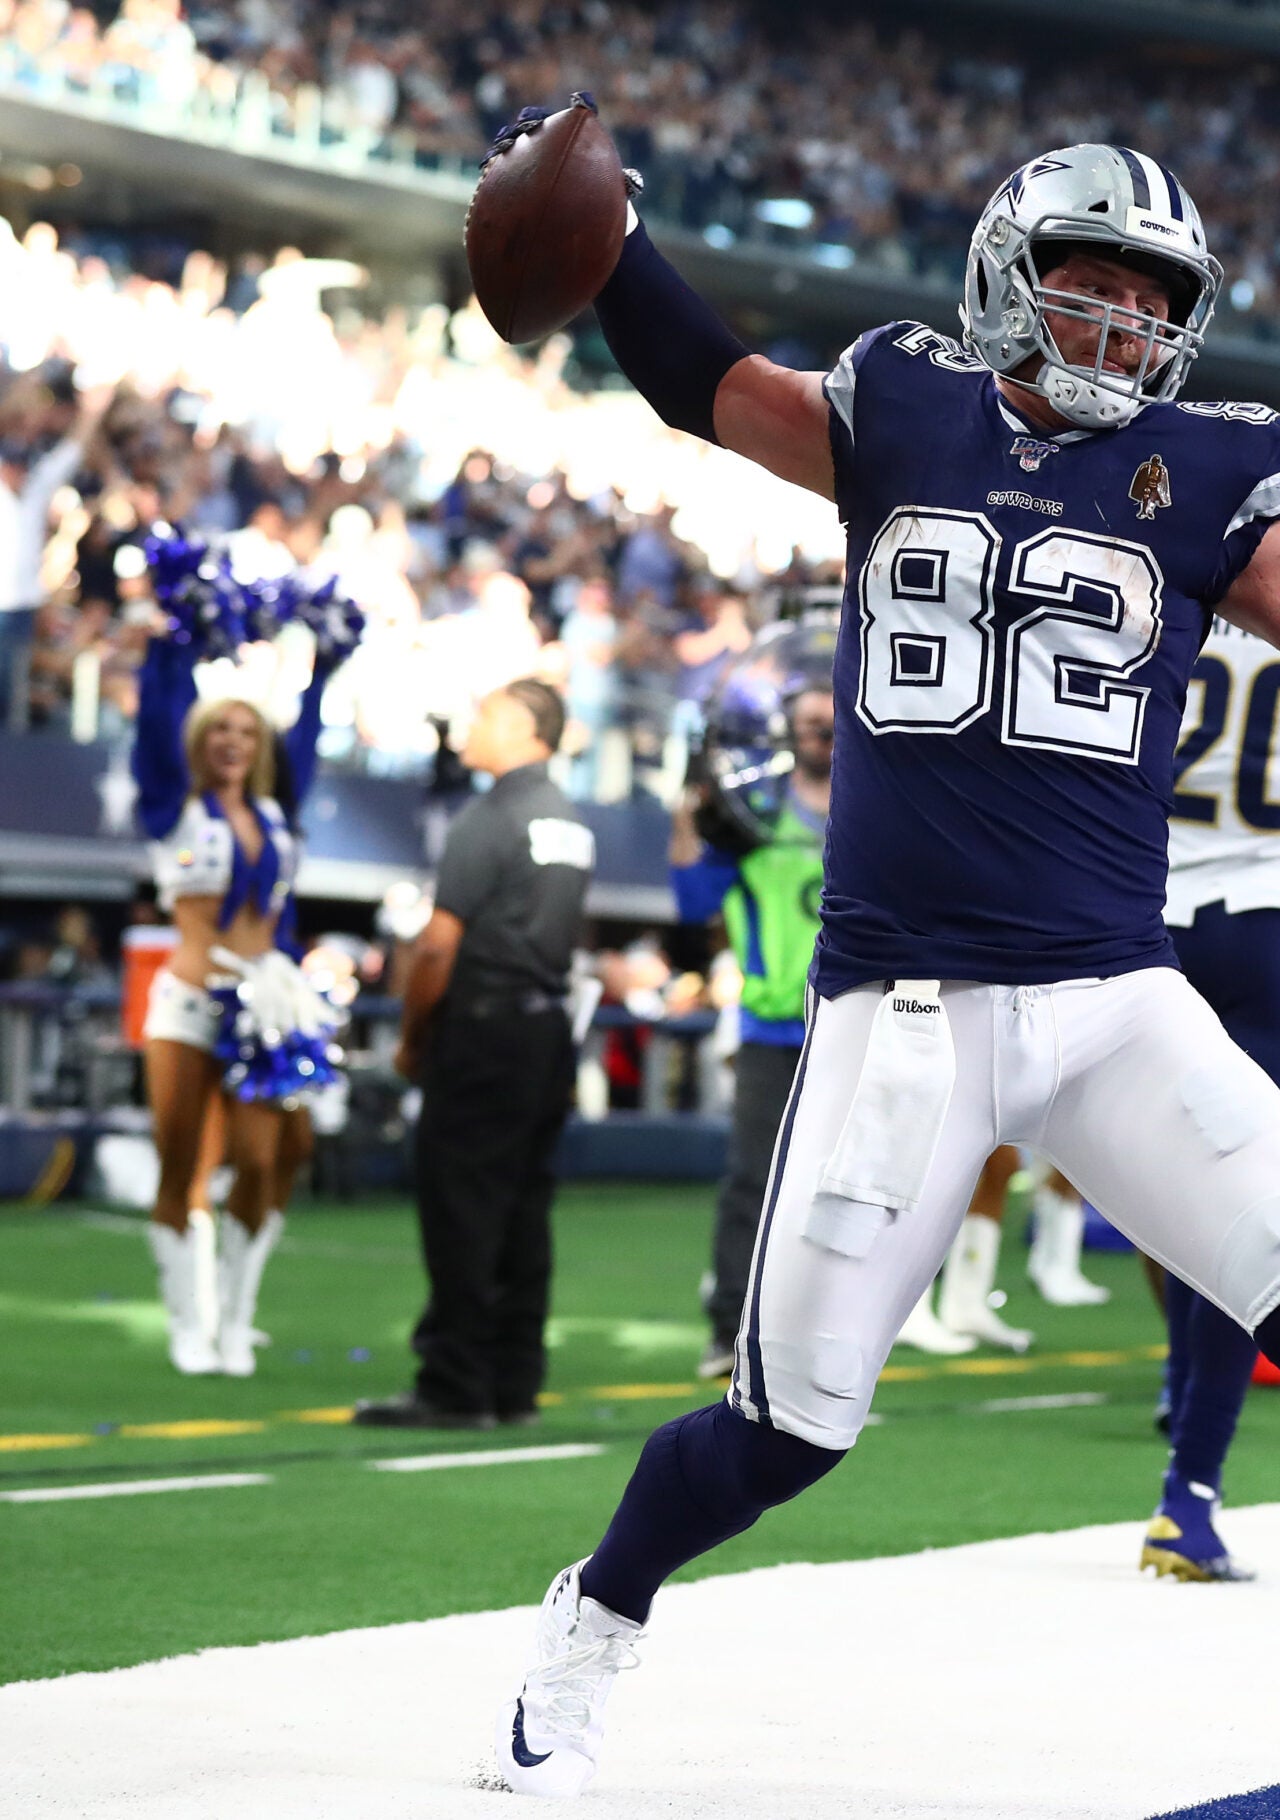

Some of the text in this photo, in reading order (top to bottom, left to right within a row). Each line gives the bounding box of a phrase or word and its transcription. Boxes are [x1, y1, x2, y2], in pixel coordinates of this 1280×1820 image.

[987, 491, 1064, 516] COWBOYS
[855, 504, 1165, 767] 82
[893, 999, 940, 1014] Wilson
